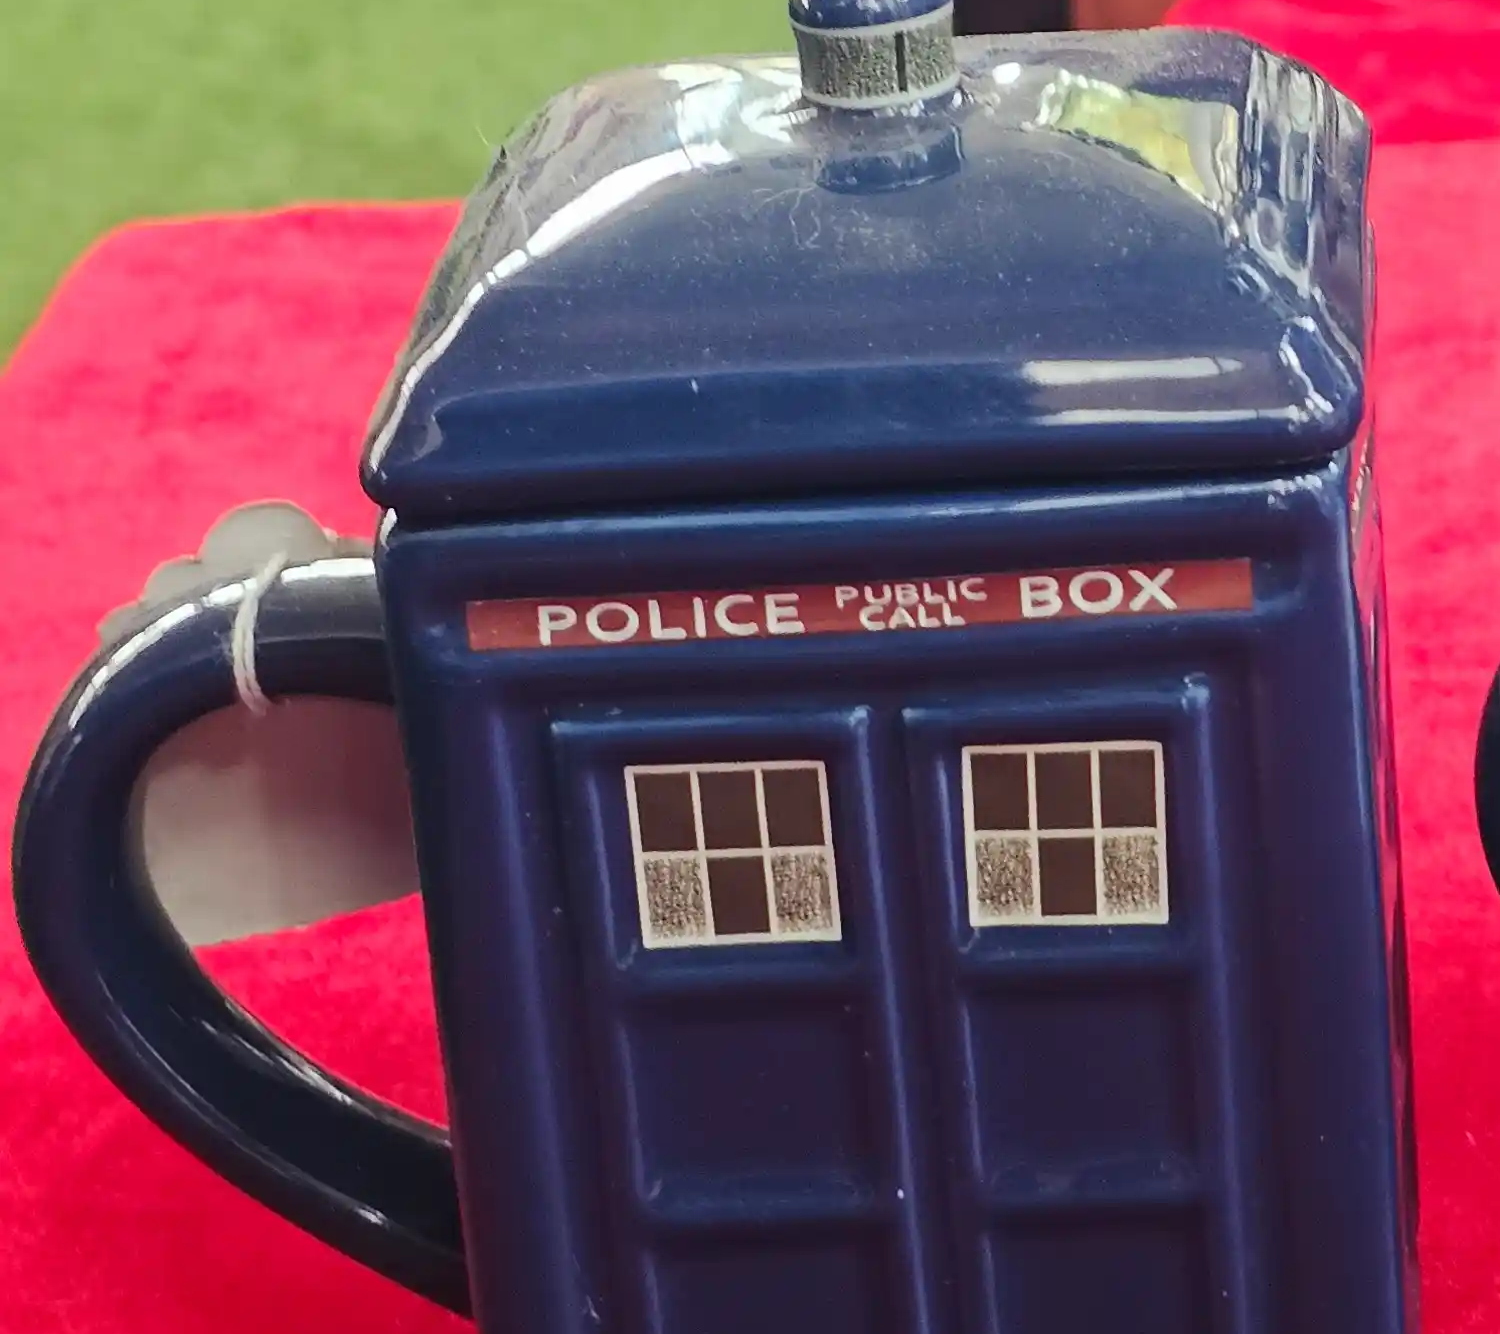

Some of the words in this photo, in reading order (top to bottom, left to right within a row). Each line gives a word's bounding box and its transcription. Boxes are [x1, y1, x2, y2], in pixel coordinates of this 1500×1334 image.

[834, 577, 988, 609] PUBLIC
[1019, 568, 1178, 619] BOX
[537, 593, 806, 646] POLICE
[859, 603, 966, 631] CALL
